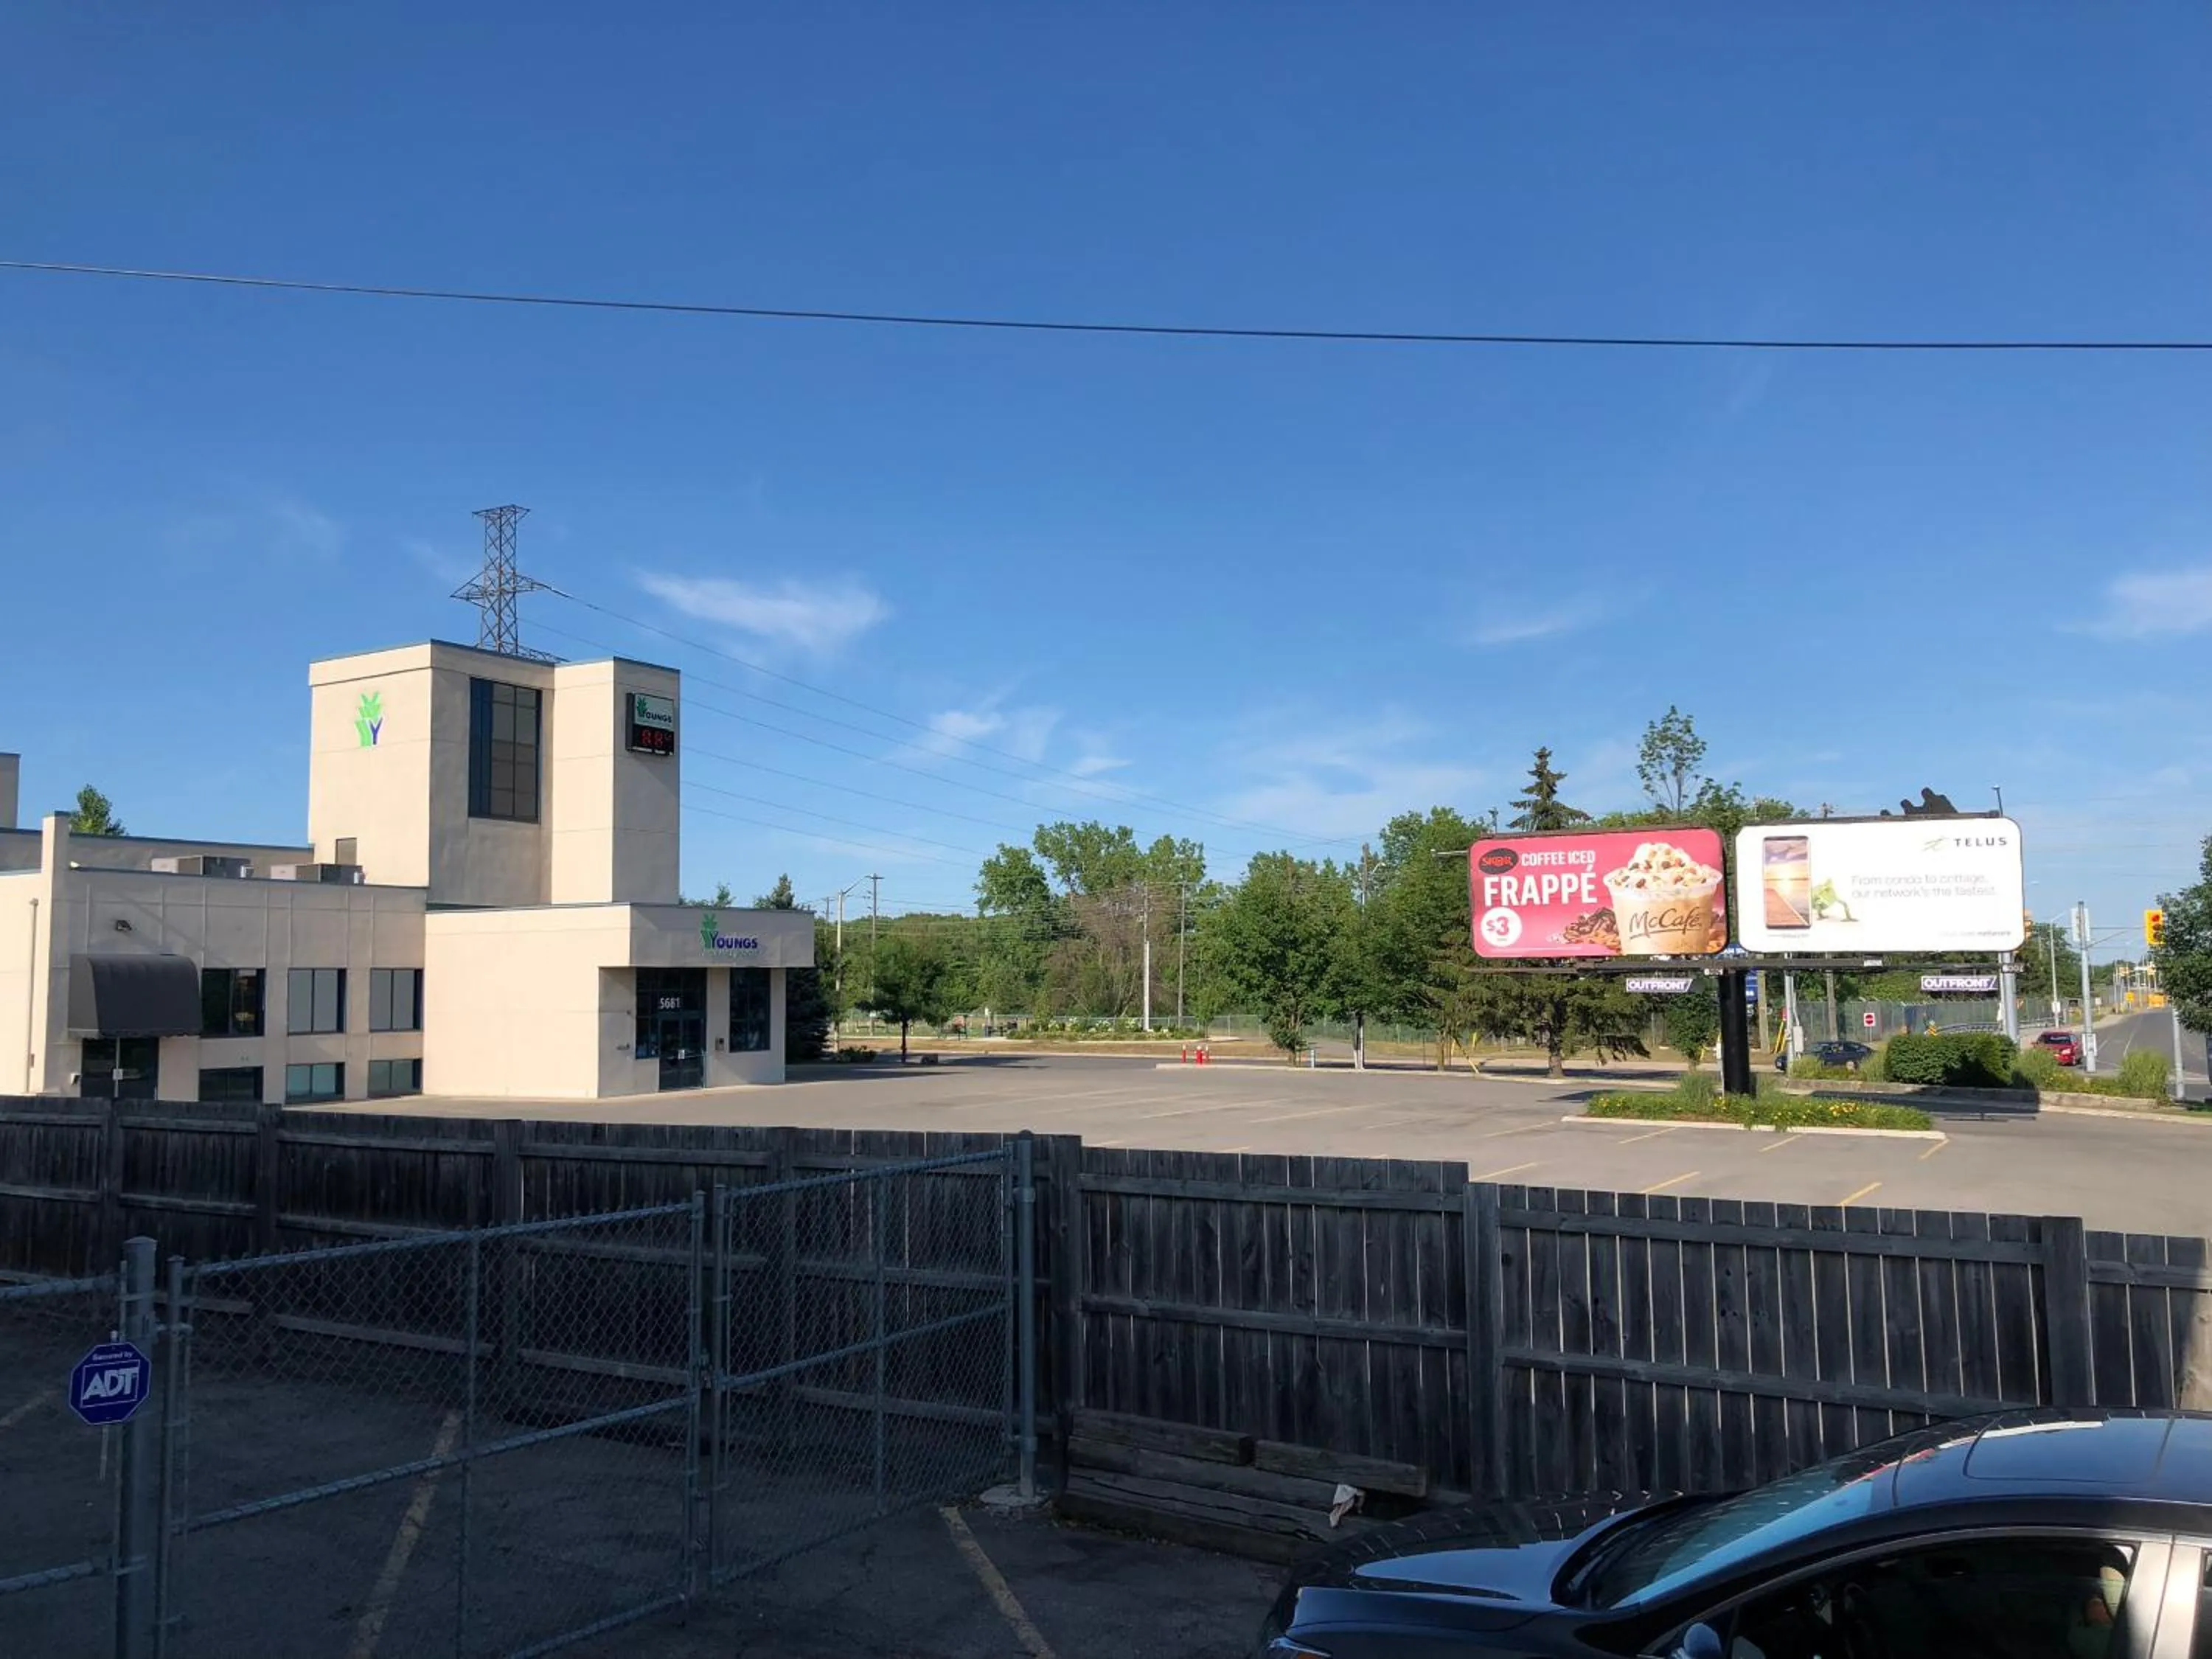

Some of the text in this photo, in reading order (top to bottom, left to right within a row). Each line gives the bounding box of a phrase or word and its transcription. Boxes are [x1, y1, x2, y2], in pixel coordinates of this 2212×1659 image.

[1953, 837, 2007, 847] TELUS
[1521, 849, 1596, 866] COFFEE ICED
[1484, 864, 1599, 907] FRAPPÉ
[1851, 875, 1882, 886] From
[1925, 874, 1936, 884] to
[1932, 886, 1952, 897] the
[1486, 916, 1510, 936] $3
[710, 930, 758, 949] YOUNGS
[82, 1366, 139, 1400] ADT
